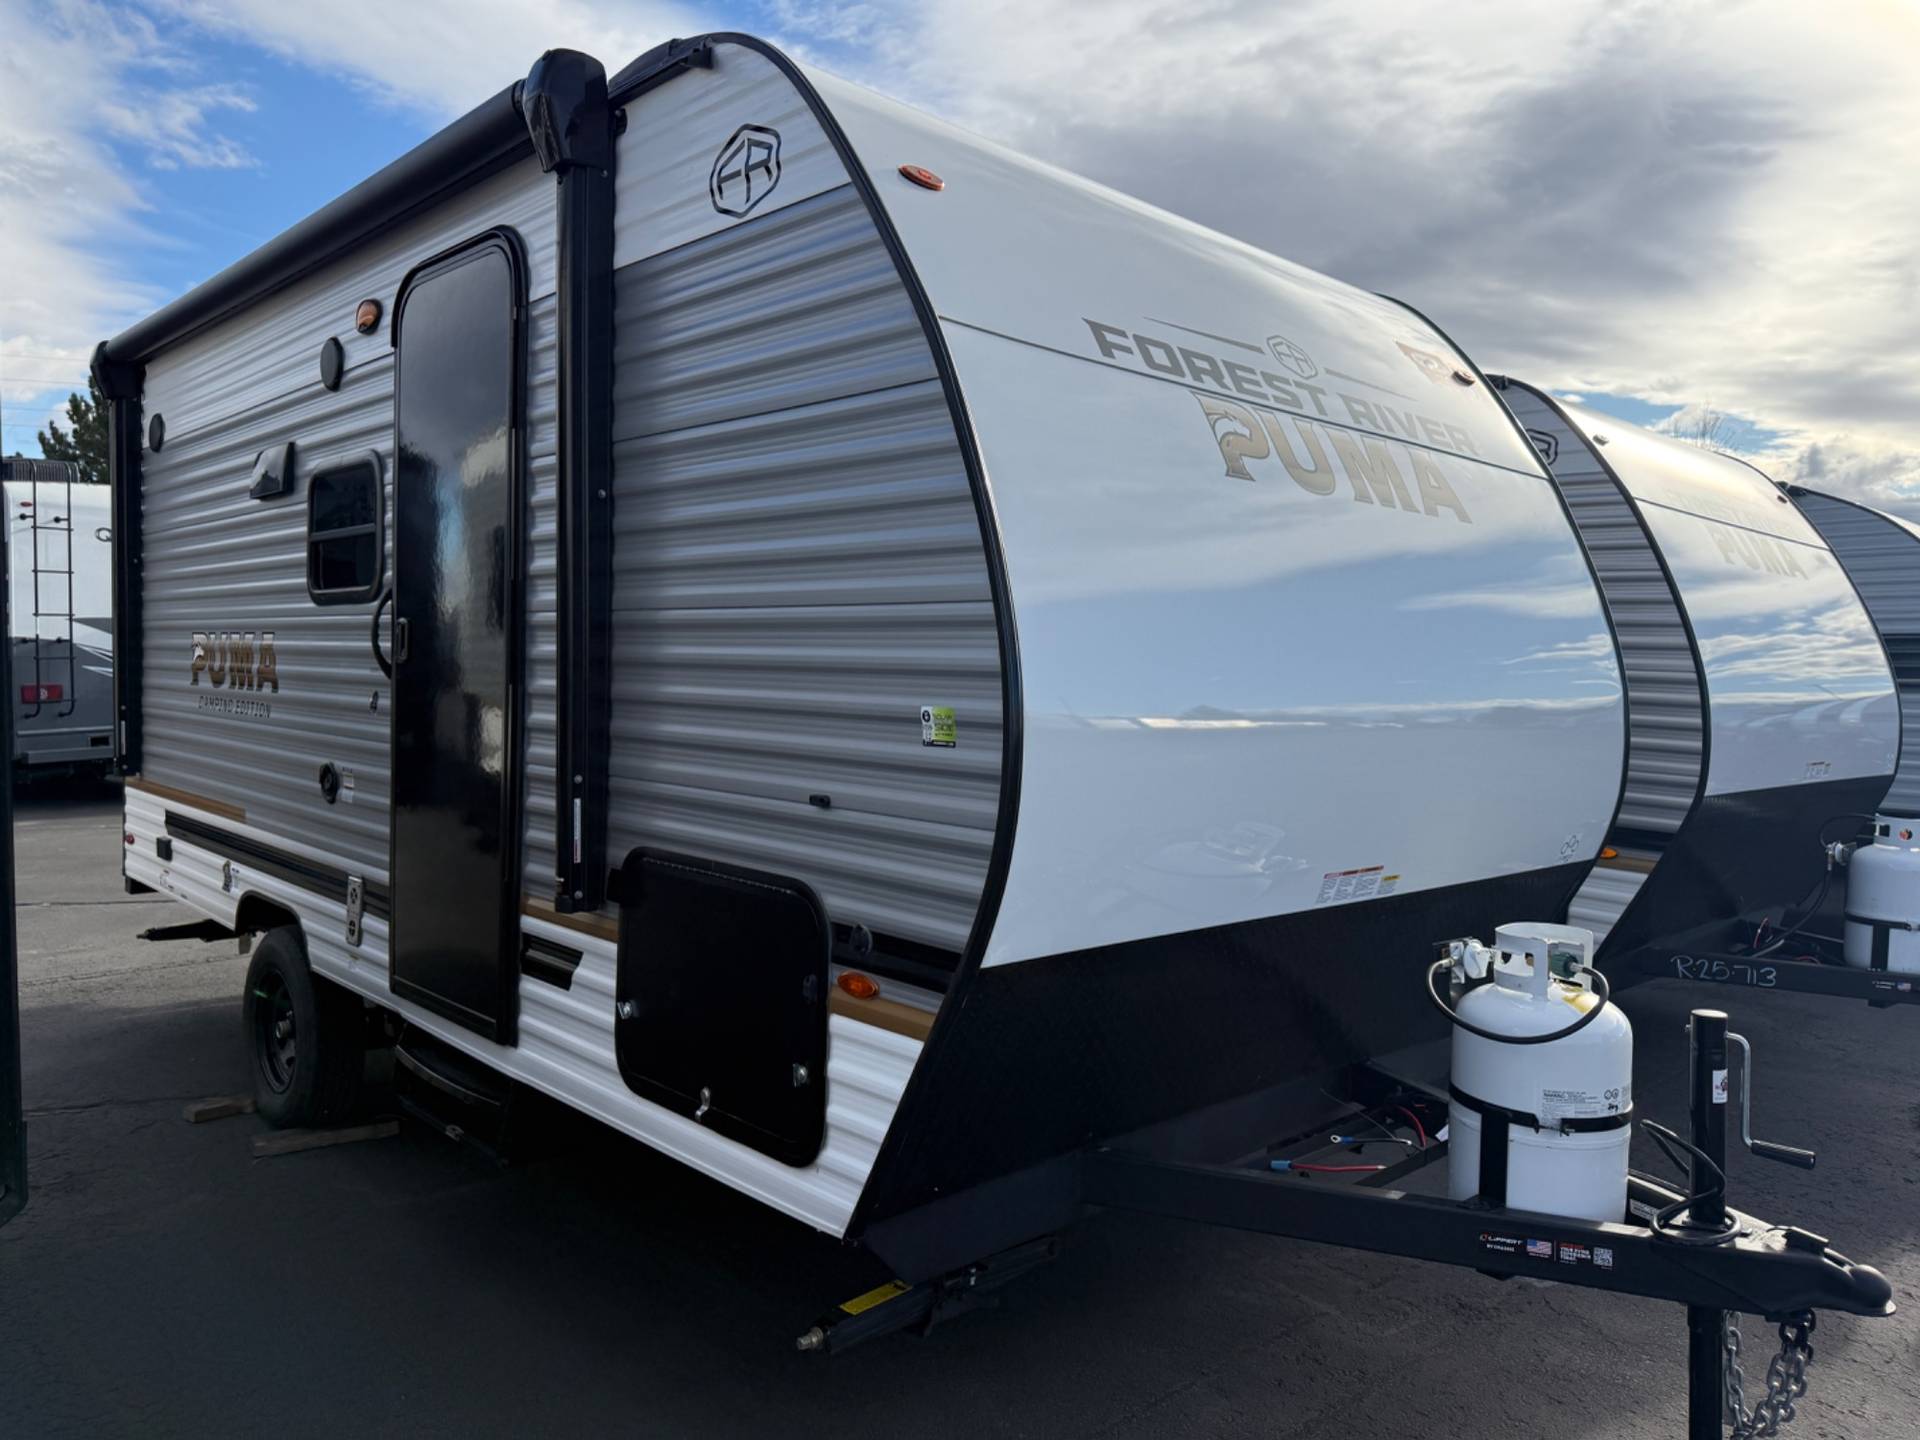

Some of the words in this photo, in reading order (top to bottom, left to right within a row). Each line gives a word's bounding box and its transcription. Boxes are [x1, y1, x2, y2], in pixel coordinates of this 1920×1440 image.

[1082, 317, 1329, 417] FOREST
[1336, 392, 1480, 456] RIVER
[1189, 390, 1473, 524] PUMA
[190, 631, 279, 694] PUMA
